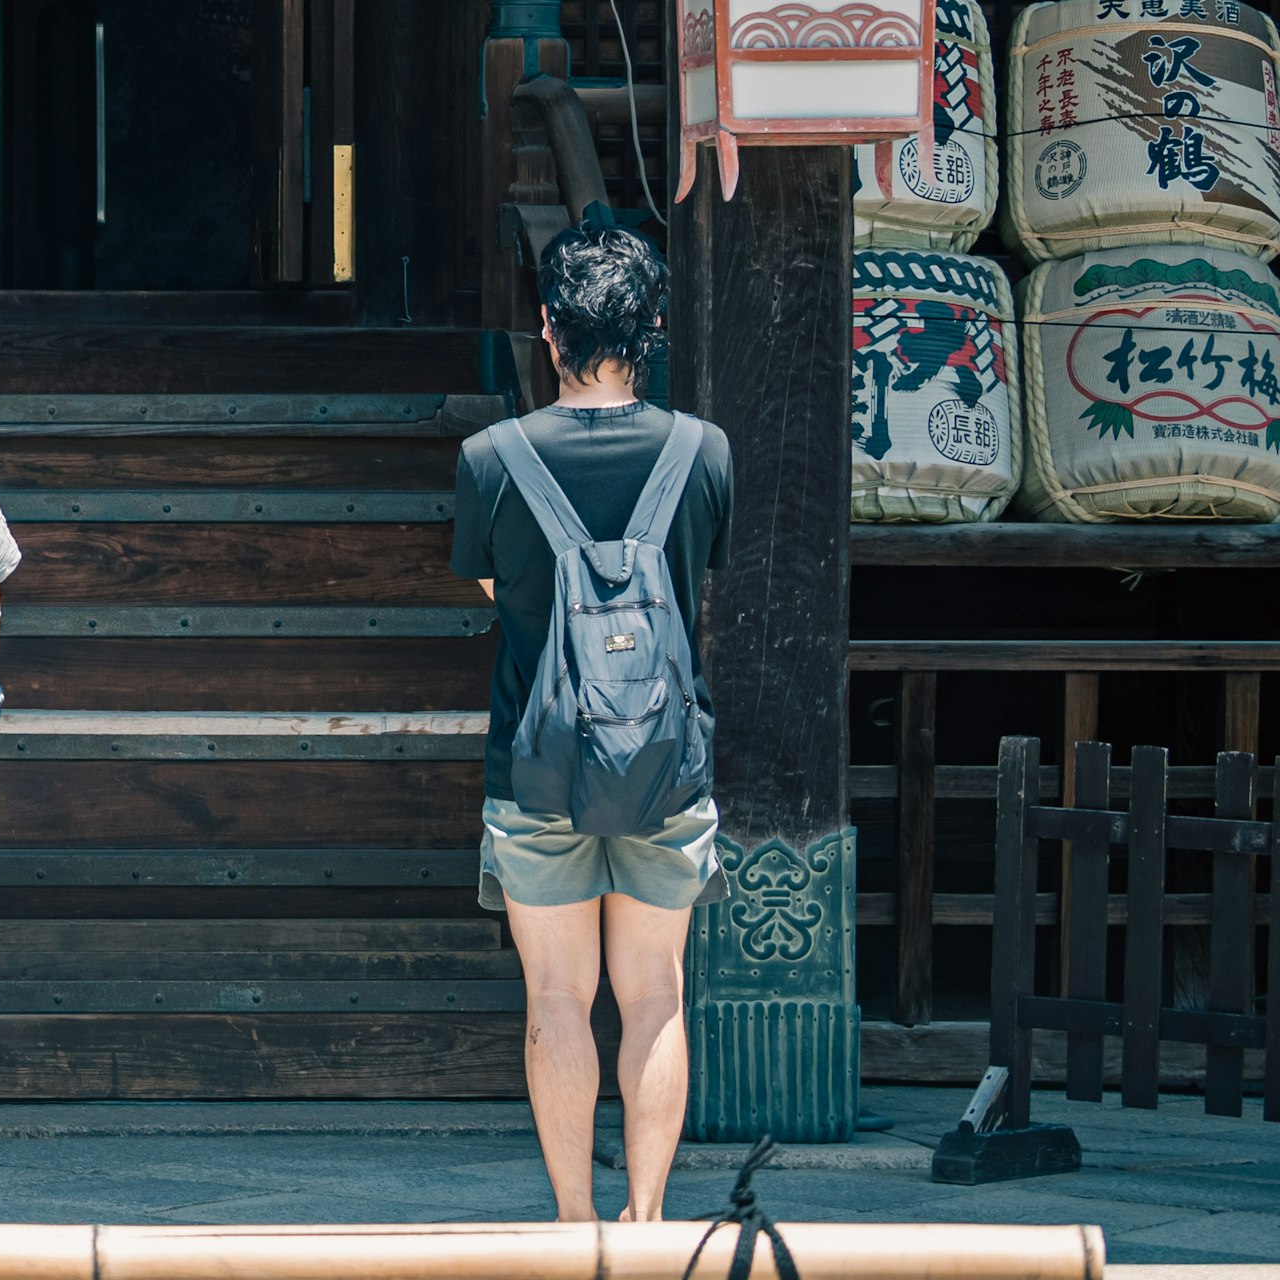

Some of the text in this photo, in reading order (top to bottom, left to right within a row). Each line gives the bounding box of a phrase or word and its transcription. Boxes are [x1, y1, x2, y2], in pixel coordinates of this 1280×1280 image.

[1141, 34, 1220, 192] 沢の鶴
[1102, 327, 1280, 406] 松竹梅
